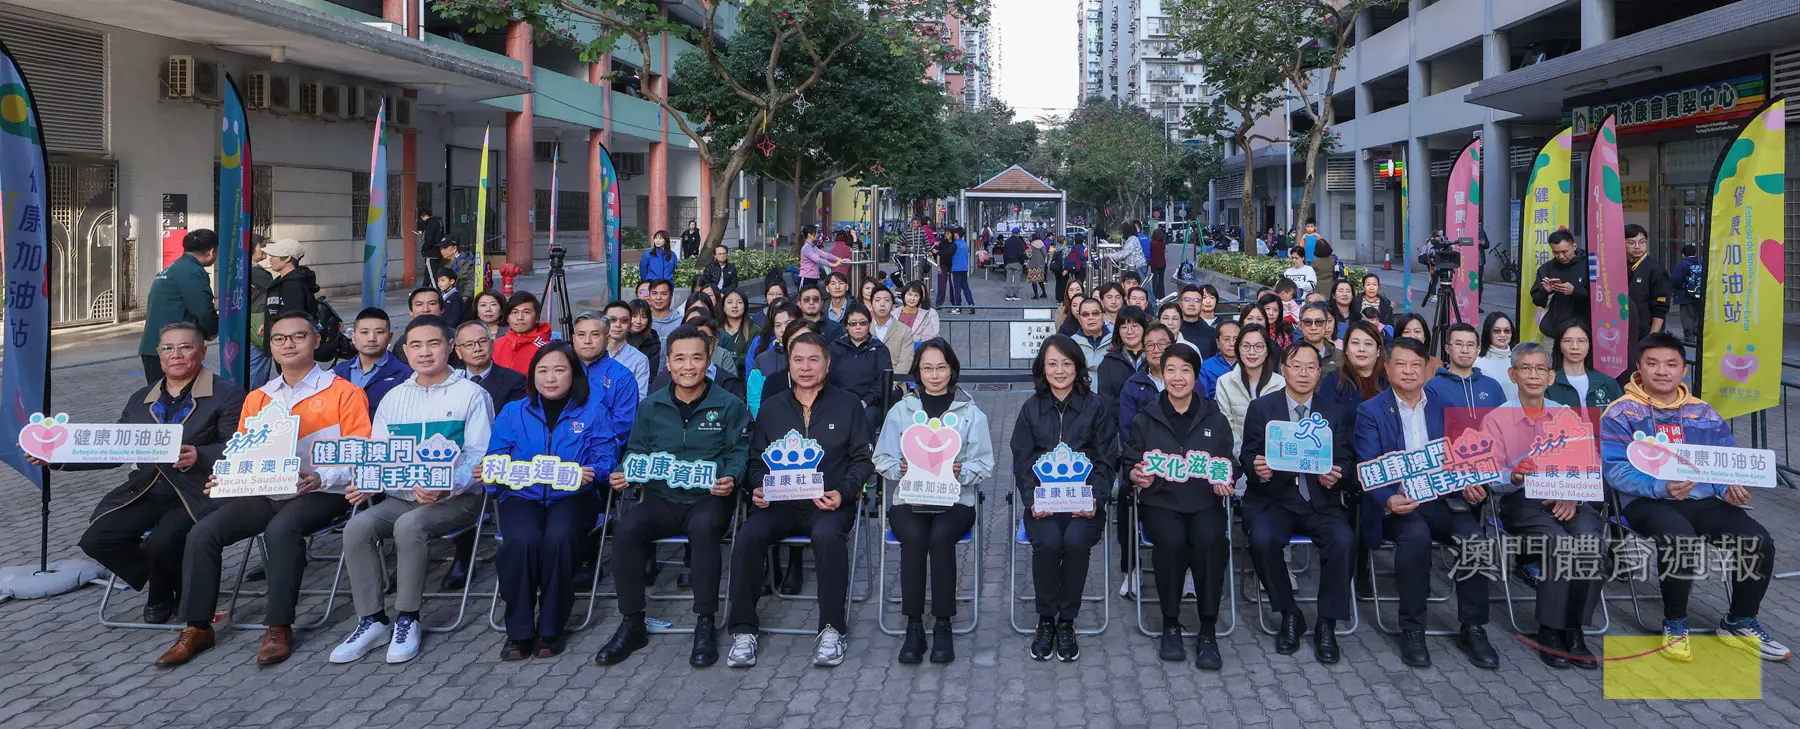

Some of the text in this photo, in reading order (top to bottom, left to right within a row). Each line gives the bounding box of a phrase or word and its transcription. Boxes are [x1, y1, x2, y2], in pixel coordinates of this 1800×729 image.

[1533, 187, 1550, 274] 健康加油
[1722, 185, 1746, 323] 健康加油站
[73, 428, 171, 446] 健康加油站
[312, 437, 413, 464] 健康澳門
[1676, 448, 1766, 471] 健康加油站
[214, 458, 299, 475] 健康澳門
[484, 456, 580, 486] 科學運動
[626, 455, 715, 486] 健康資訊
[1145, 453, 1230, 482] 文化滋養
[1360, 440, 1454, 488] 健康澳門
[216, 474, 297, 486] Macau Saudável
[355, 465, 452, 491] 攜手共創
[764, 473, 823, 487] 健康社區
[901, 480, 959, 494] 健康加油站
[1405, 459, 1502, 501] 攜手共創
[1526, 479, 1601, 490] Macau Saudável
[1036, 486, 1092, 499] 健康社區
[1532, 489, 1596, 498] Healthy Macao
